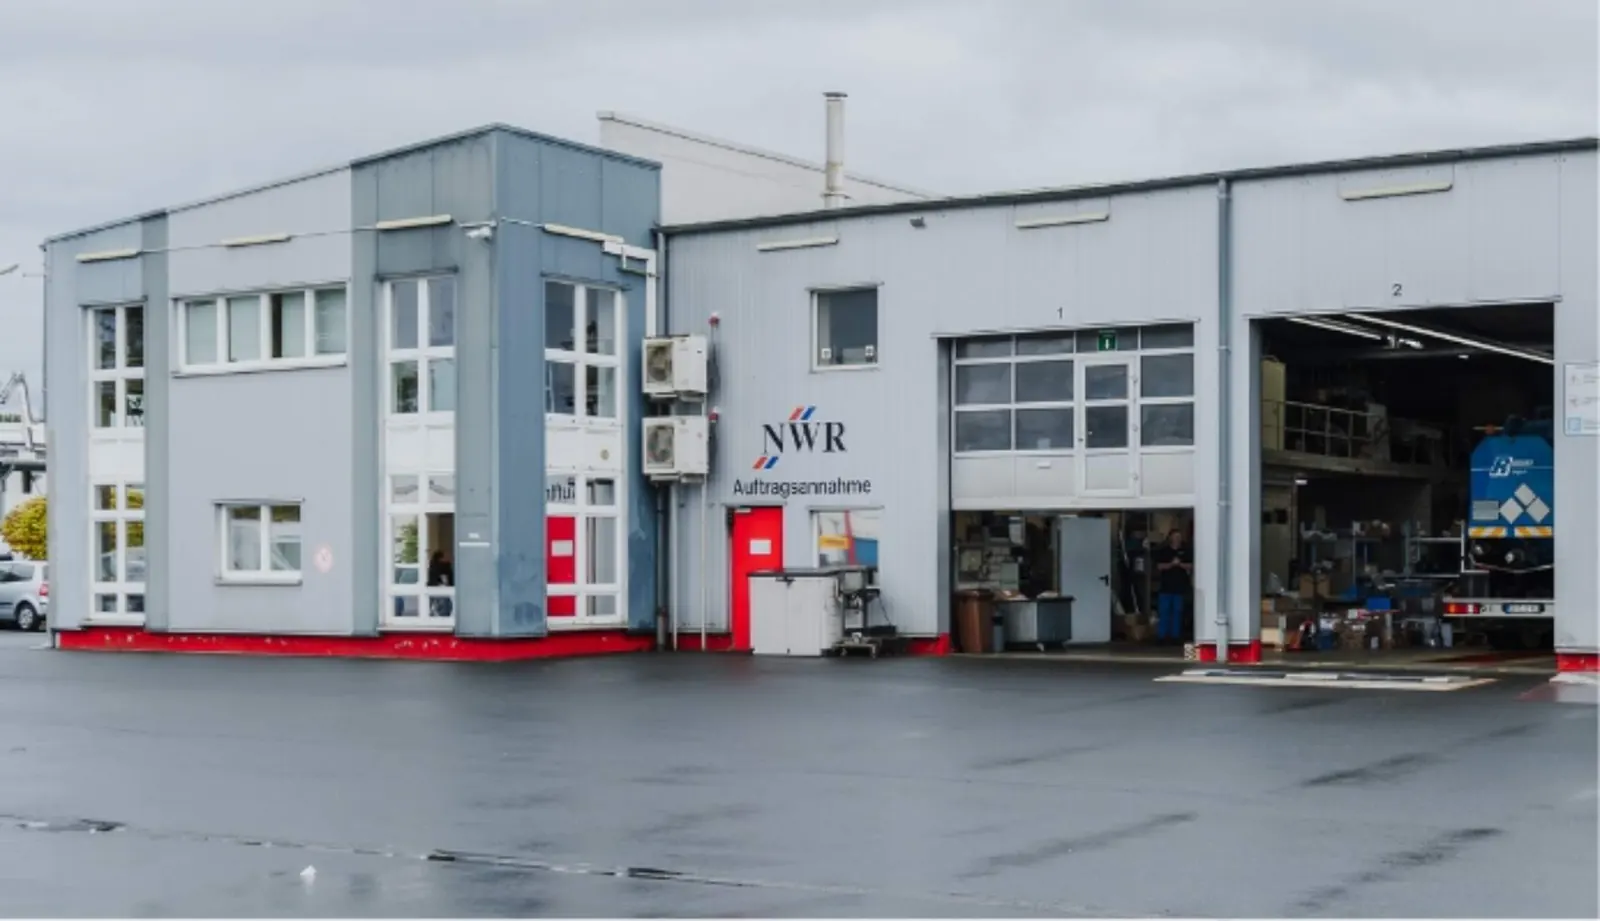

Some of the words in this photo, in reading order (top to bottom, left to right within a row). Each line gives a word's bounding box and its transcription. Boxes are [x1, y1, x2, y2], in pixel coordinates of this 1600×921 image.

[1392, 283, 1402, 297] 2
[1056, 306, 1063, 320] 1
[762, 421, 848, 454] NWR
[733, 477, 872, 498] Auftragsannahme
